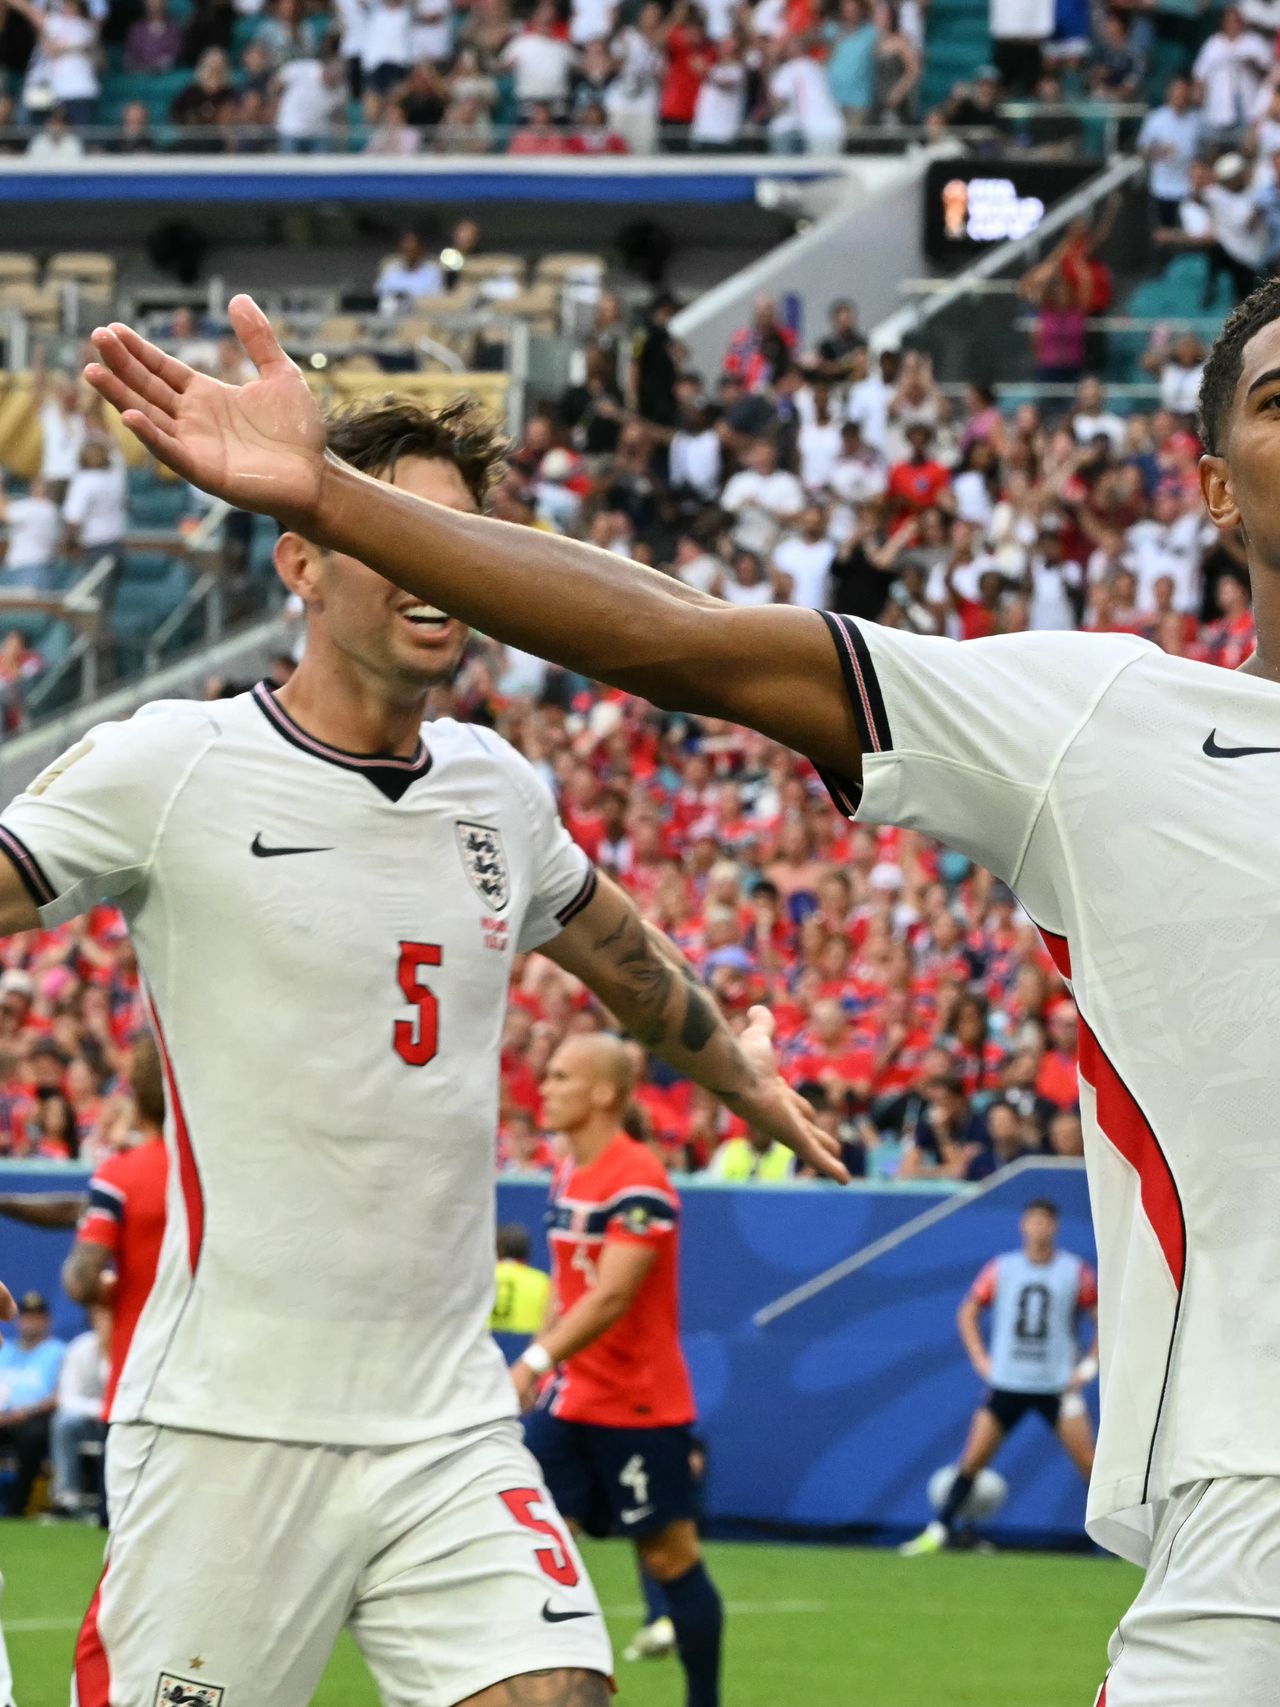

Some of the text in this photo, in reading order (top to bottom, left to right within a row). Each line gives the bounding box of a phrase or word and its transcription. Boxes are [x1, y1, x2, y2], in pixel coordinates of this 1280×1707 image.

[392, 940, 443, 1066] 5
[619, 1453, 648, 1504] 4
[498, 1487, 579, 1587] 5
